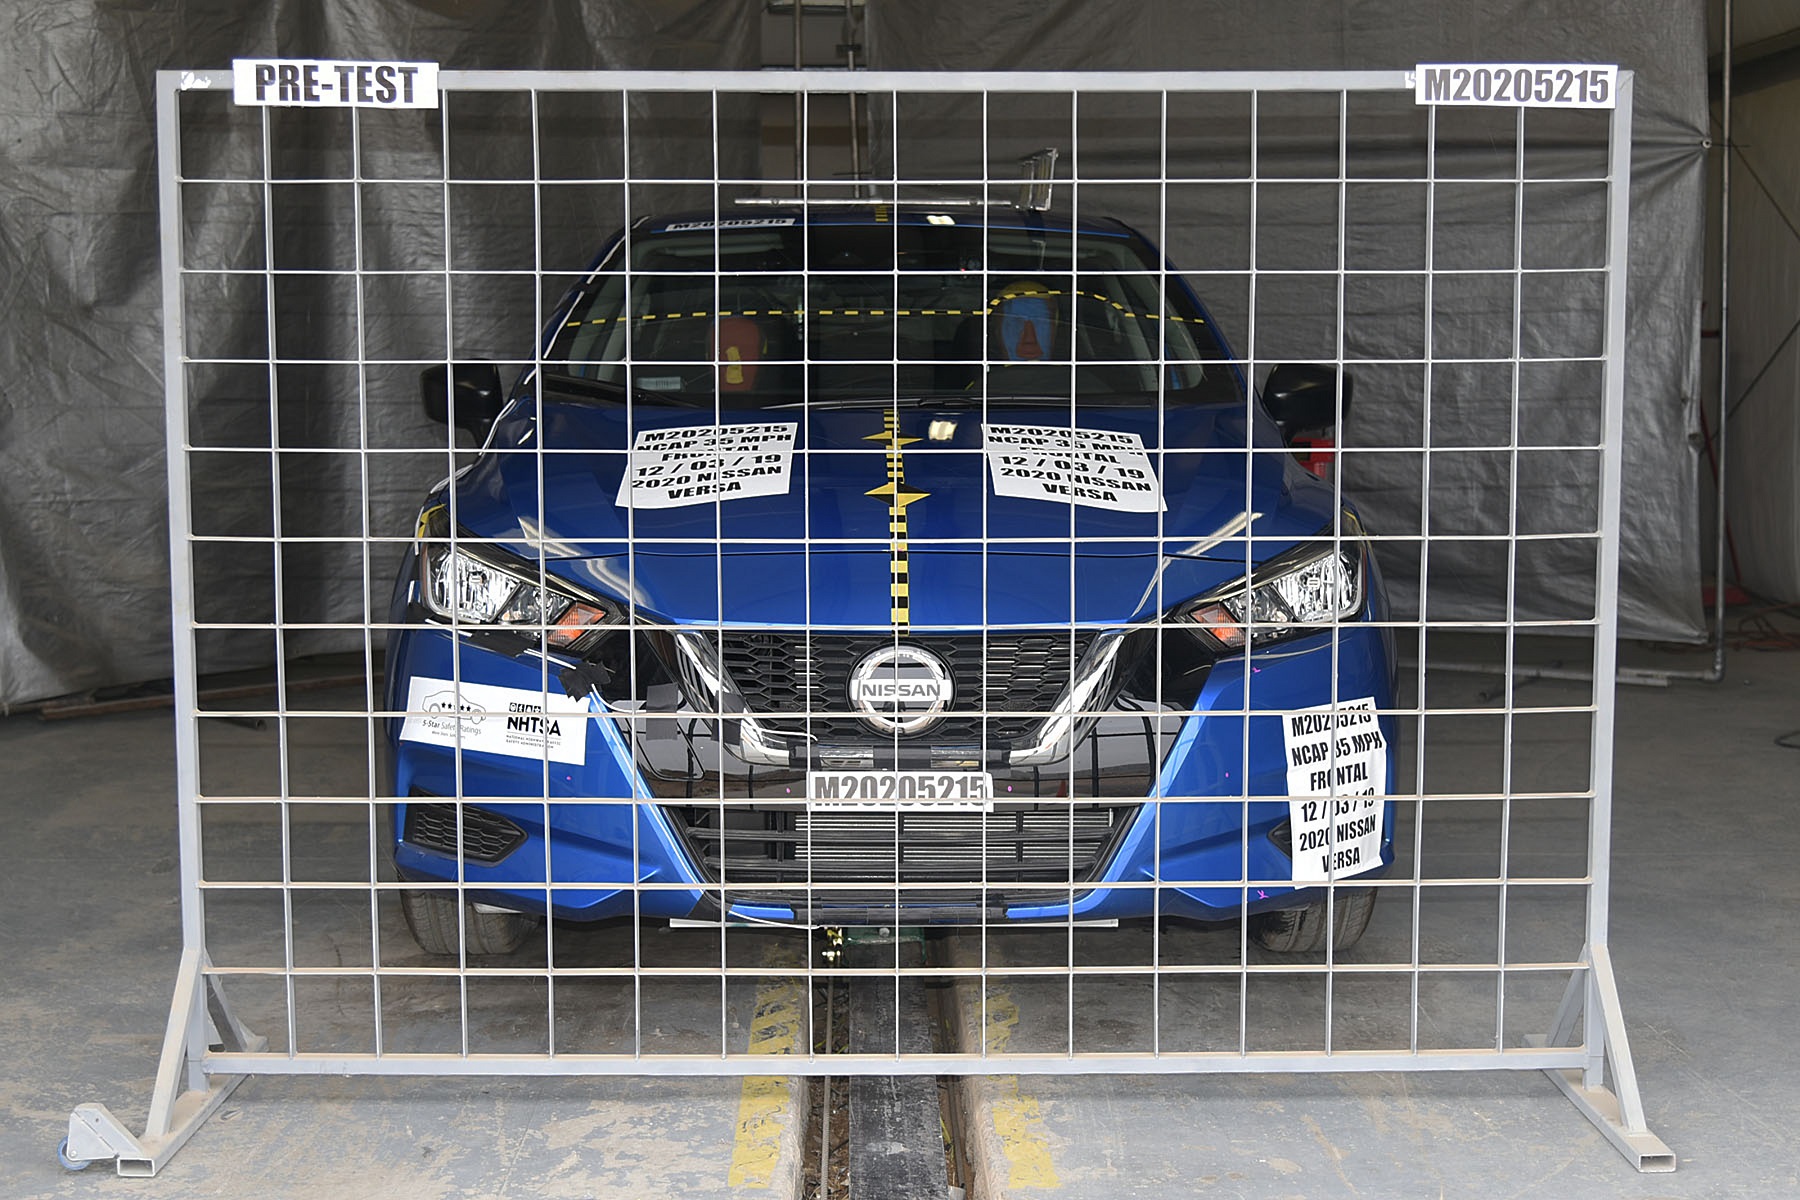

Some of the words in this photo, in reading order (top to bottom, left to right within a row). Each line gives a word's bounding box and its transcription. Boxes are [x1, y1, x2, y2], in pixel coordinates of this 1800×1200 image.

[256, 64, 418, 104] PRE-TEST
[1424, 68, 1609, 103] M20205215
[645, 425, 788, 441] M20205215
[740, 434, 792, 443] MPH
[988, 436, 1049, 445] NCAP
[990, 427, 1133, 443] M20205215
[637, 466, 664, 477] 12
[691, 459, 724, 471] 03
[752, 454, 781, 464] 19
[999, 456, 1028, 466] 12
[1054, 460, 1089, 472] 03
[1114, 467, 1145, 479] 19
[632, 475, 691, 488] 2020
[668, 481, 741, 499] VERSA
[1001, 468, 1061, 481] 2020
[1067, 474, 1152, 491] NISSAN
[1042, 483, 1118, 502] VERSA
[863, 684, 941, 697] NISSAN
[507, 716, 561, 737] NHTSA
[1292, 741, 1329, 767] NCAP
[1352, 731, 1383, 755] MPH
[815, 775, 984, 806] M20205215
[1301, 801, 1317, 823] 12
[1336, 813, 1376, 843] NISSAN
